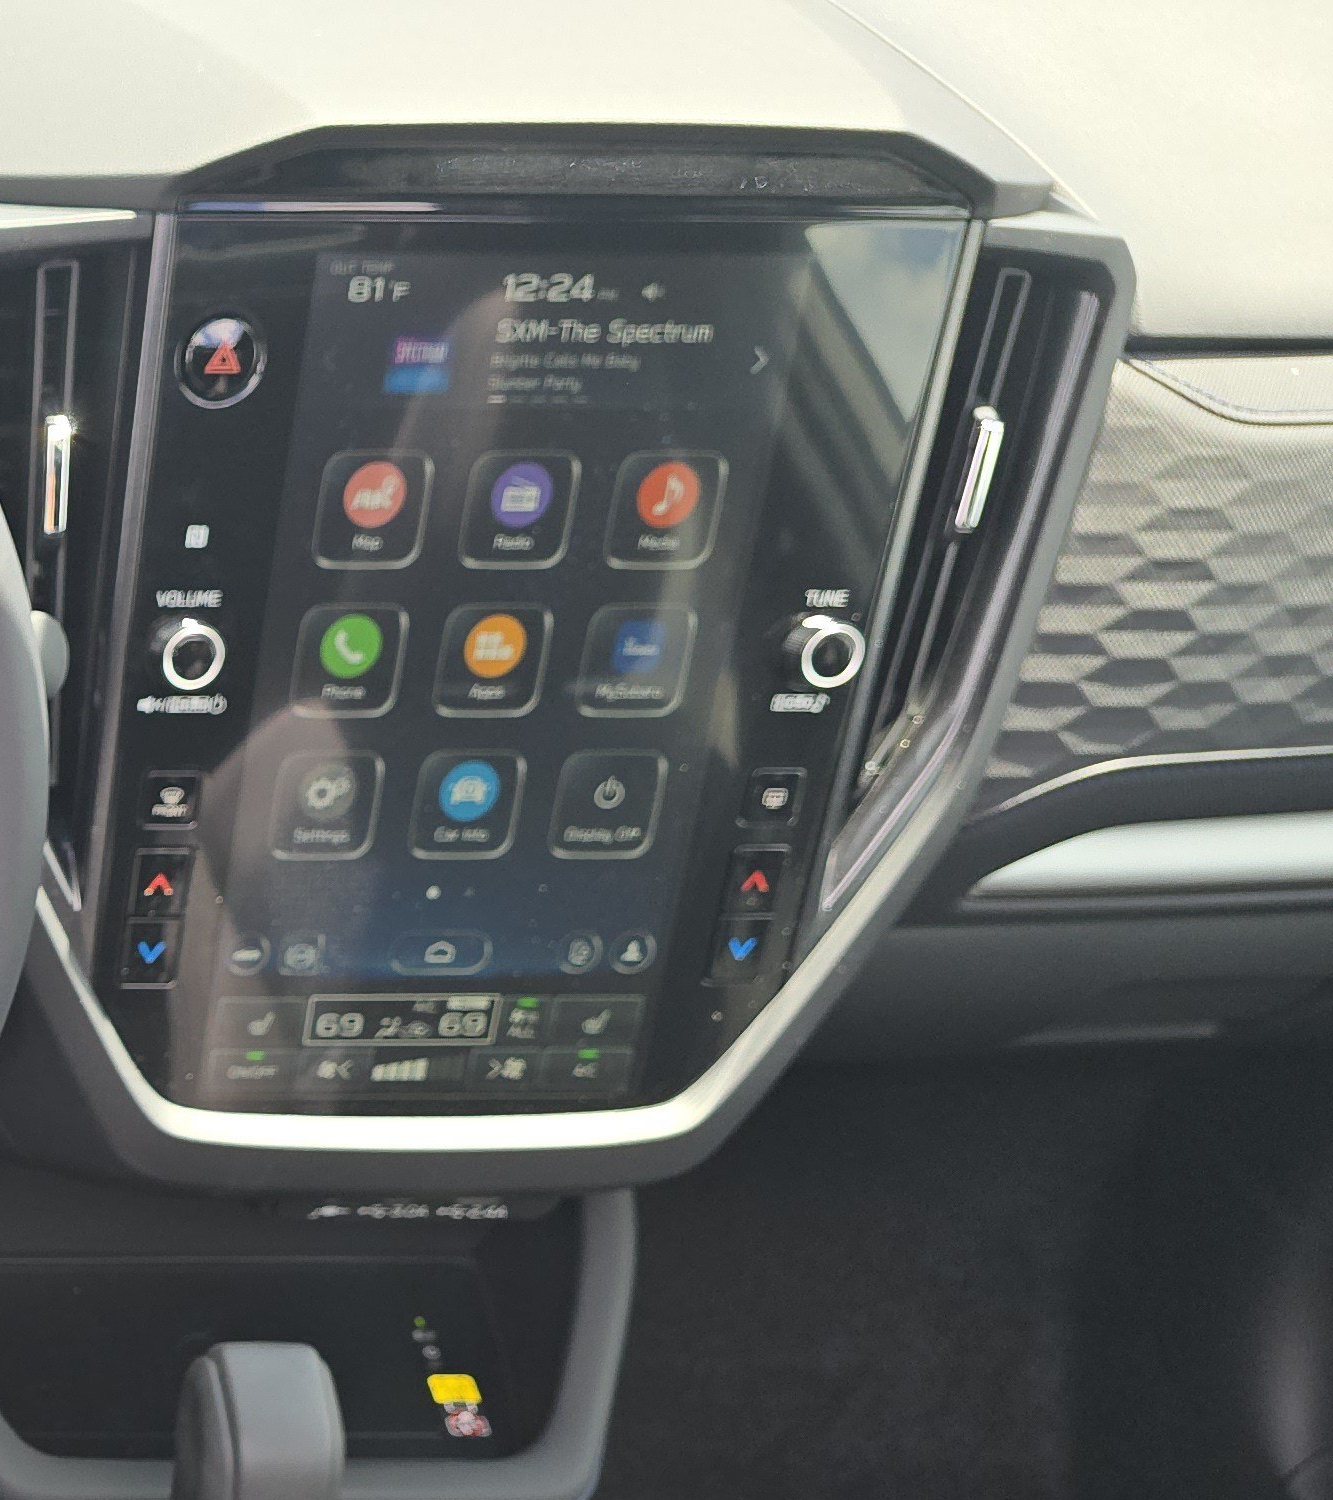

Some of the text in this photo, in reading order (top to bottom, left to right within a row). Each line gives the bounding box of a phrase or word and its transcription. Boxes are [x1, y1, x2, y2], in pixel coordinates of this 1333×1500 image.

[502, 273, 597, 303] 12:24
[495, 317, 714, 348] SXM-The Spectrum
[156, 589, 223, 608] VOLUME
[804, 588, 850, 608] TUNE
[316, 1012, 365, 1038] 69
